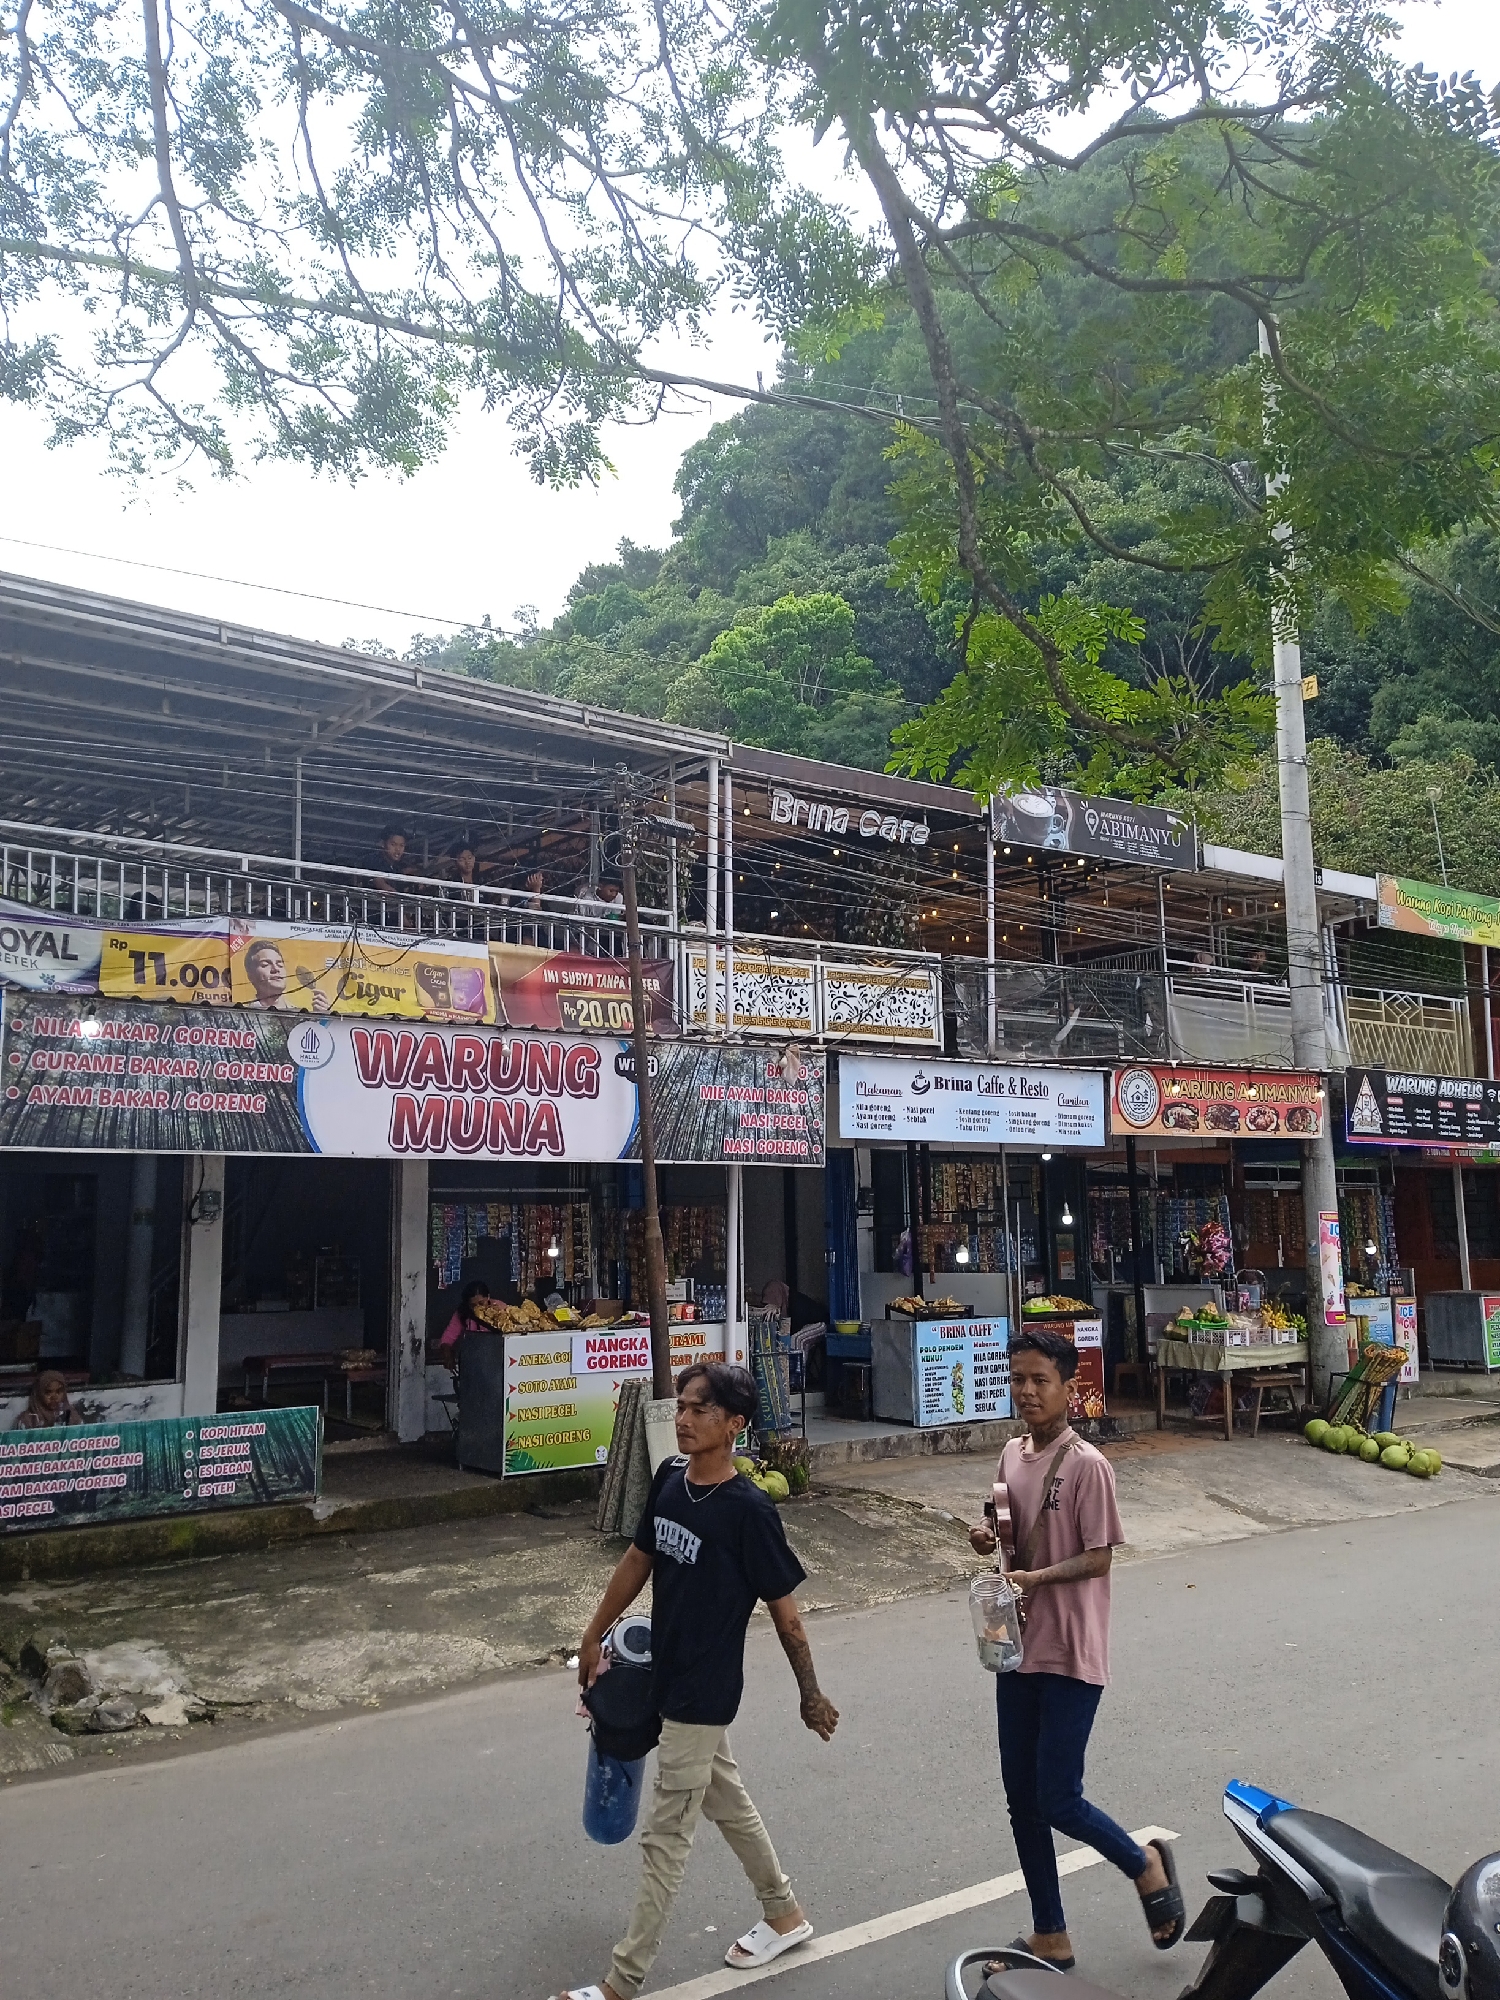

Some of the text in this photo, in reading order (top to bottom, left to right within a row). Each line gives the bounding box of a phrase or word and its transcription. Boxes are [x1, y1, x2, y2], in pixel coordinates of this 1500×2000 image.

[771, 789, 930, 845] Brina Cafe
[1100, 820, 1181, 847] ABIMANYU
[1434, 897, 1454, 919] Kopi
[110, 939, 128, 951] Rp
[230, 936, 244, 952] NEW
[0, 952, 38, 969] ETEK
[544, 969, 558, 983] INI
[561, 971, 593, 987] SURYA
[596, 974, 625, 990] TANPA
[192, 991, 231, 1003] /Bung
[336, 972, 406, 1006] Cigar
[563, 1002, 577, 1020] Rp
[577, 999, 634, 1029] 20.00
[34, 1017, 81, 1037] NILA
[174, 1025, 256, 1048] GORENG
[31, 1050, 126, 1074] GURAME
[129, 1056, 199, 1078] BAKAR
[214, 1061, 294, 1083] GORENG
[351, 1027, 600, 1098] WARUNG
[766, 1063, 808, 1079] BAO
[856, 1081, 903, 1097] Makanan
[934, 1074, 1049, 1097] Brina Caffe & Resto
[1161, 1078, 1235, 1100] WARUNG
[1386, 1075, 1483, 1100] WARUNG ADHELIS
[26, 1085, 93, 1106] AYAM
[98, 1088, 169, 1109] BAKAR
[184, 1091, 267, 1113] GORENG
[700, 1085, 808, 1105] MIE AYAM BAKSO
[388, 1093, 566, 1155] MUNA
[740, 1113, 808, 1130] NASI PECEL
[723, 1138, 808, 1155] NASI GORENG
[1400, 1306, 1413, 1317] ICE
[940, 1323, 992, 1338] BRINA CAFFE
[586, 1337, 649, 1354] NANGKA
[518, 1351, 571, 1367] ANEKA GO
[587, 1353, 648, 1370] GORENG
[670, 1354, 692, 1366] KAR
[974, 1353, 986, 1362] NILA
[974, 1363, 1010, 1374] AYAM GOREN
[518, 1377, 577, 1394] SOTO AYAM
[974, 1378, 988, 1387] NASI
[975, 1389, 1006, 1400] NASI PECEL
[518, 1403, 577, 1422] NASI PECEL
[975, 1402, 996, 1412] SEBLAK
[200, 1423, 265, 1440] KOPI HITAM
[518, 1428, 591, 1449] NASI GORENG
[18, 1441, 60, 1456] BAKAR
[69, 1435, 120, 1452] GORENG
[200, 1442, 250, 1459] ES JERUK
[42, 1458, 84, 1474] BAKAR
[93, 1453, 143, 1469] GORENG
[199, 1461, 252, 1478] ES DEGAN
[0, 1483, 23, 1498] AM
[25, 1480, 67, 1496] BAKAR
[76, 1473, 127, 1490] GORENG
[198, 1481, 235, 1497] ES TEH
[17, 1501, 55, 1517] PECEL
